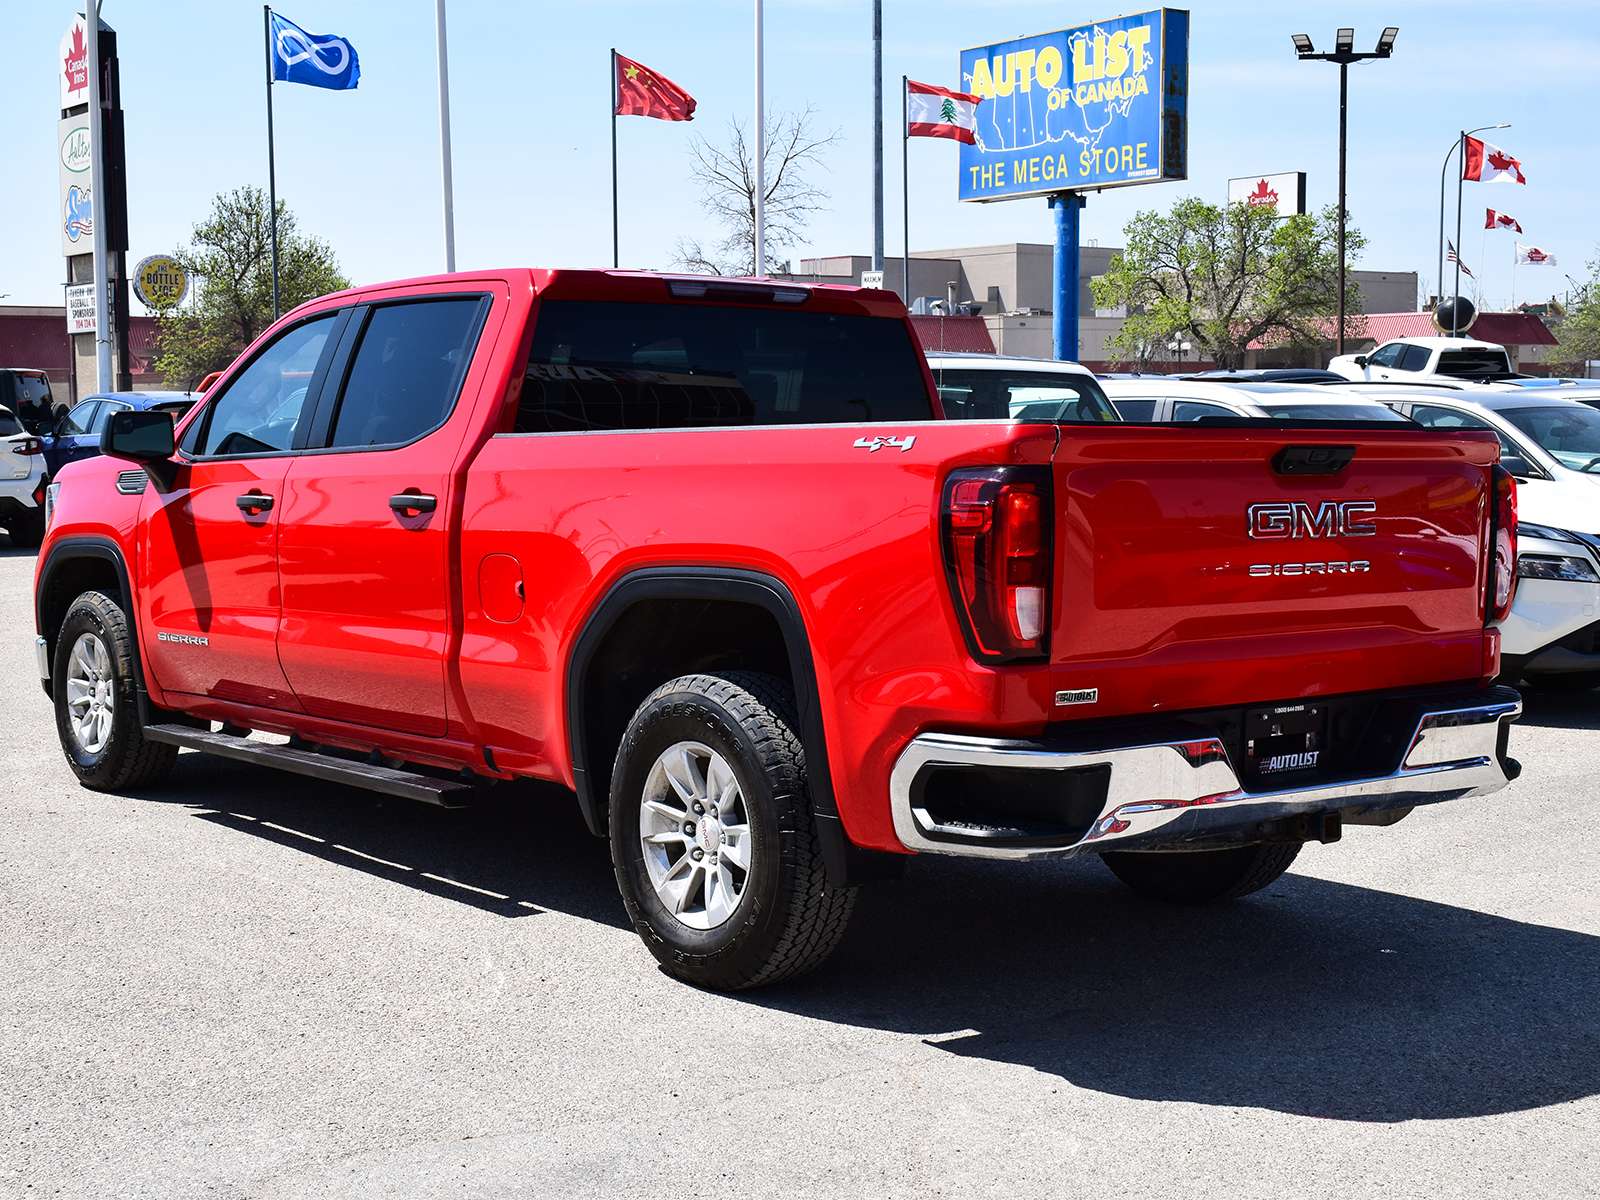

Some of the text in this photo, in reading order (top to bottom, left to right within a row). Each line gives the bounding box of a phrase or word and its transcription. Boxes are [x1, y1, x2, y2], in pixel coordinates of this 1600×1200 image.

[971, 25, 1150, 99] AUTO LIST
[1047, 75, 1149, 110] OF CANADA
[970, 143, 1148, 190] THE MEGA STORE
[146, 272, 180, 285] BOTTLE
[1248, 502, 1377, 540] GMC
[1248, 560, 1371, 577] SIERRA
[157, 631, 209, 647] SIERRA
[701, 820, 711, 849] GMC
